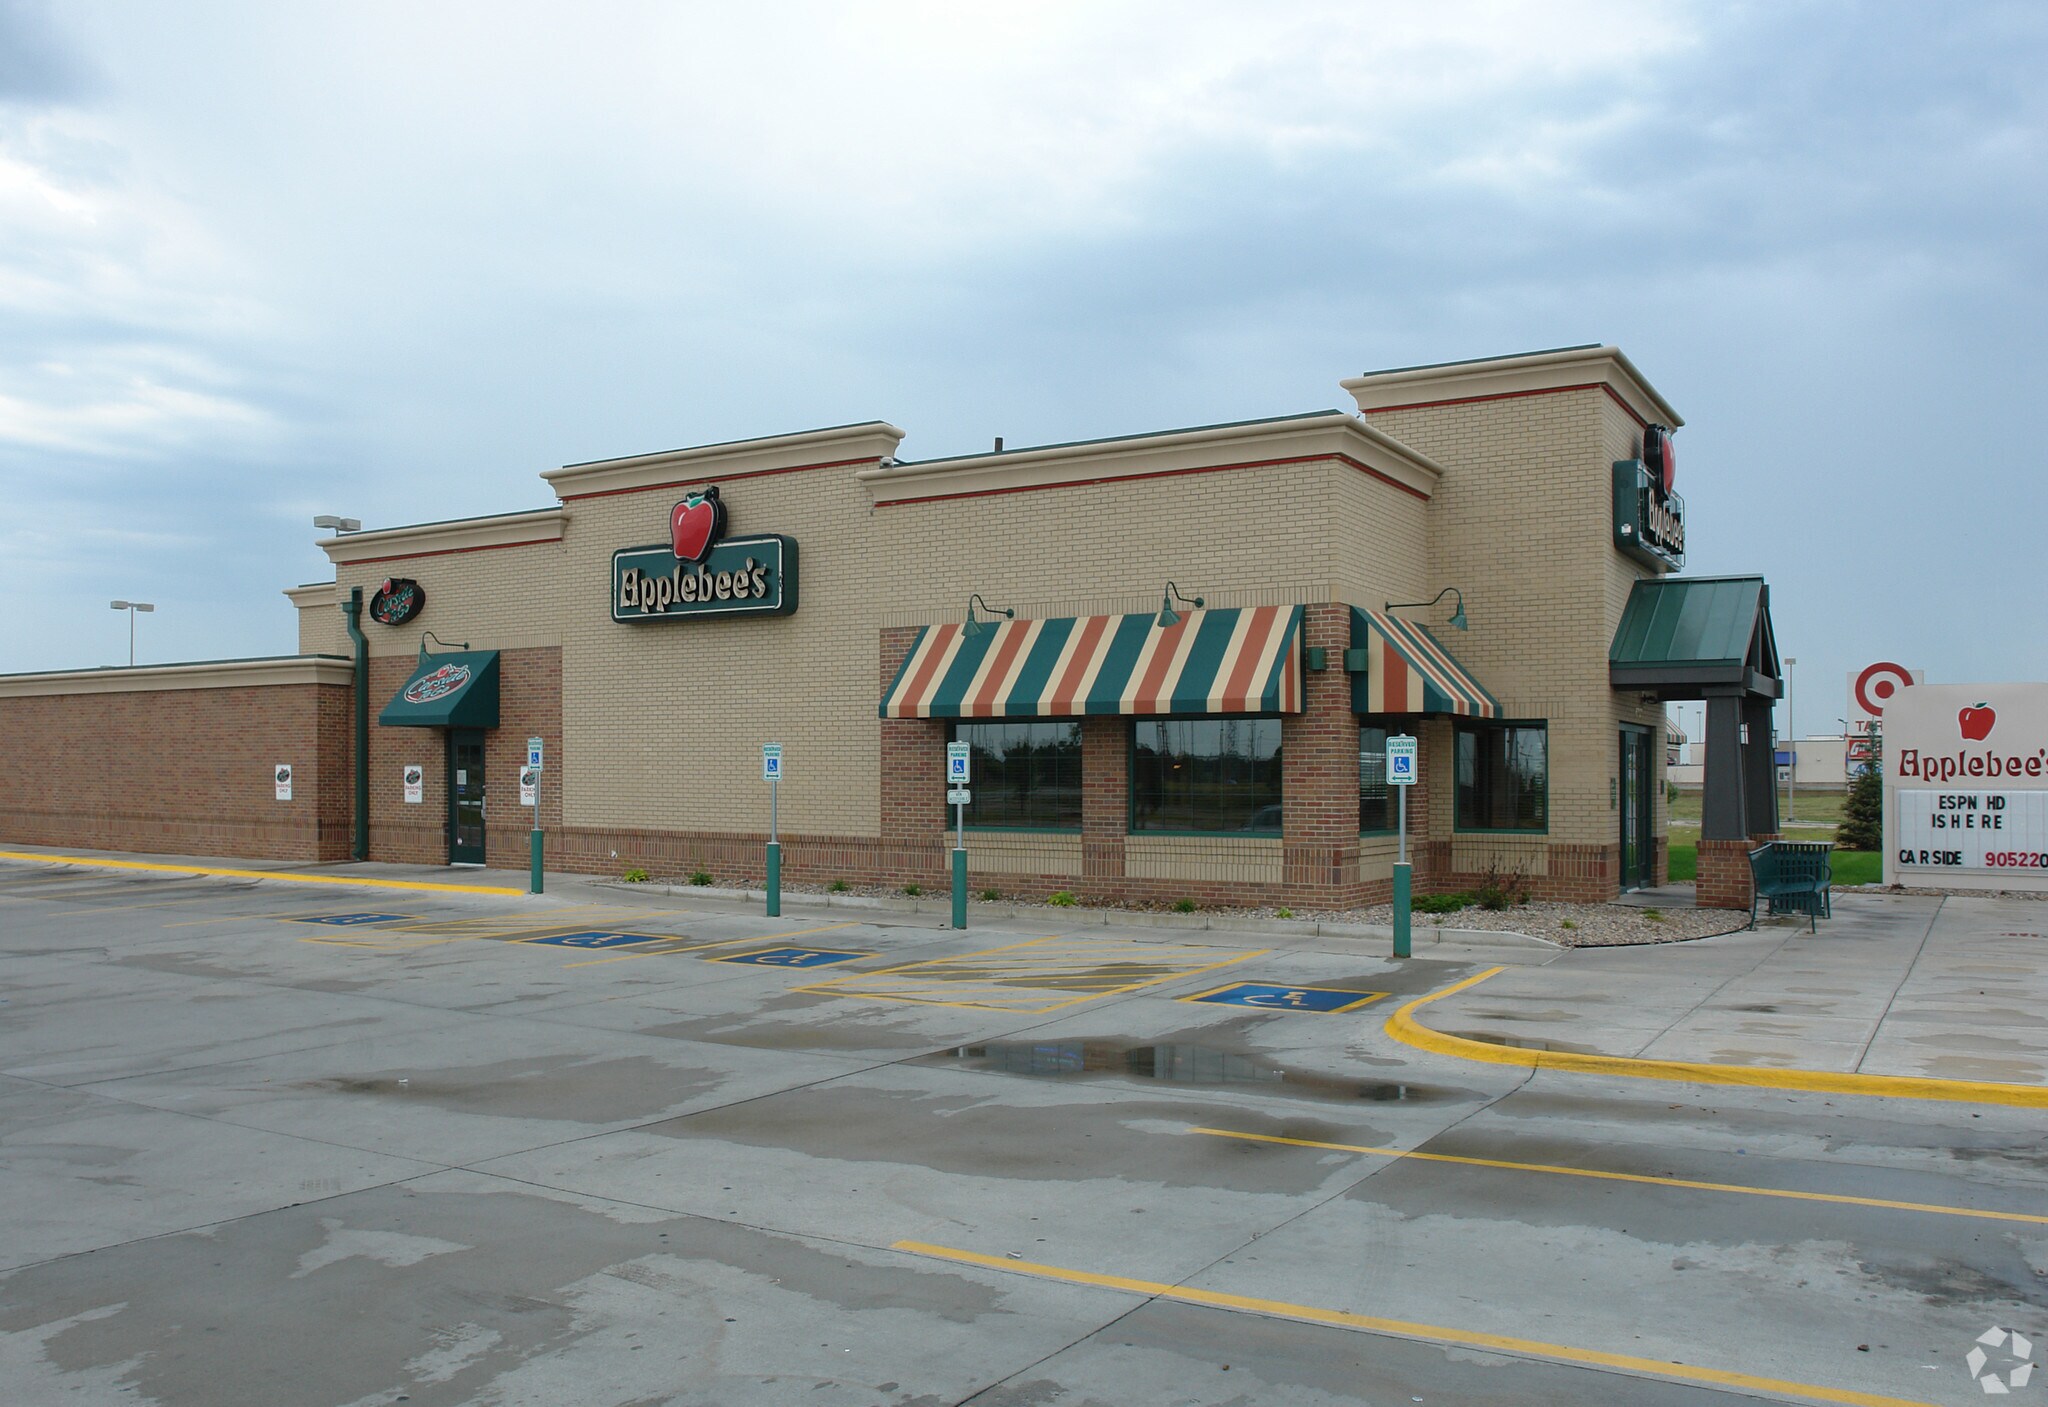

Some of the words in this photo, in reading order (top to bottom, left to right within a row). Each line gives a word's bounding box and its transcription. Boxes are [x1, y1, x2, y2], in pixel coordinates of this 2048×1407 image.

[620, 557, 767, 613] Applebee's
[1899, 748, 2048, 782] Applebee'
[1939, 795, 1977, 810] ESPN
[1986, 795, 2006, 810] HD
